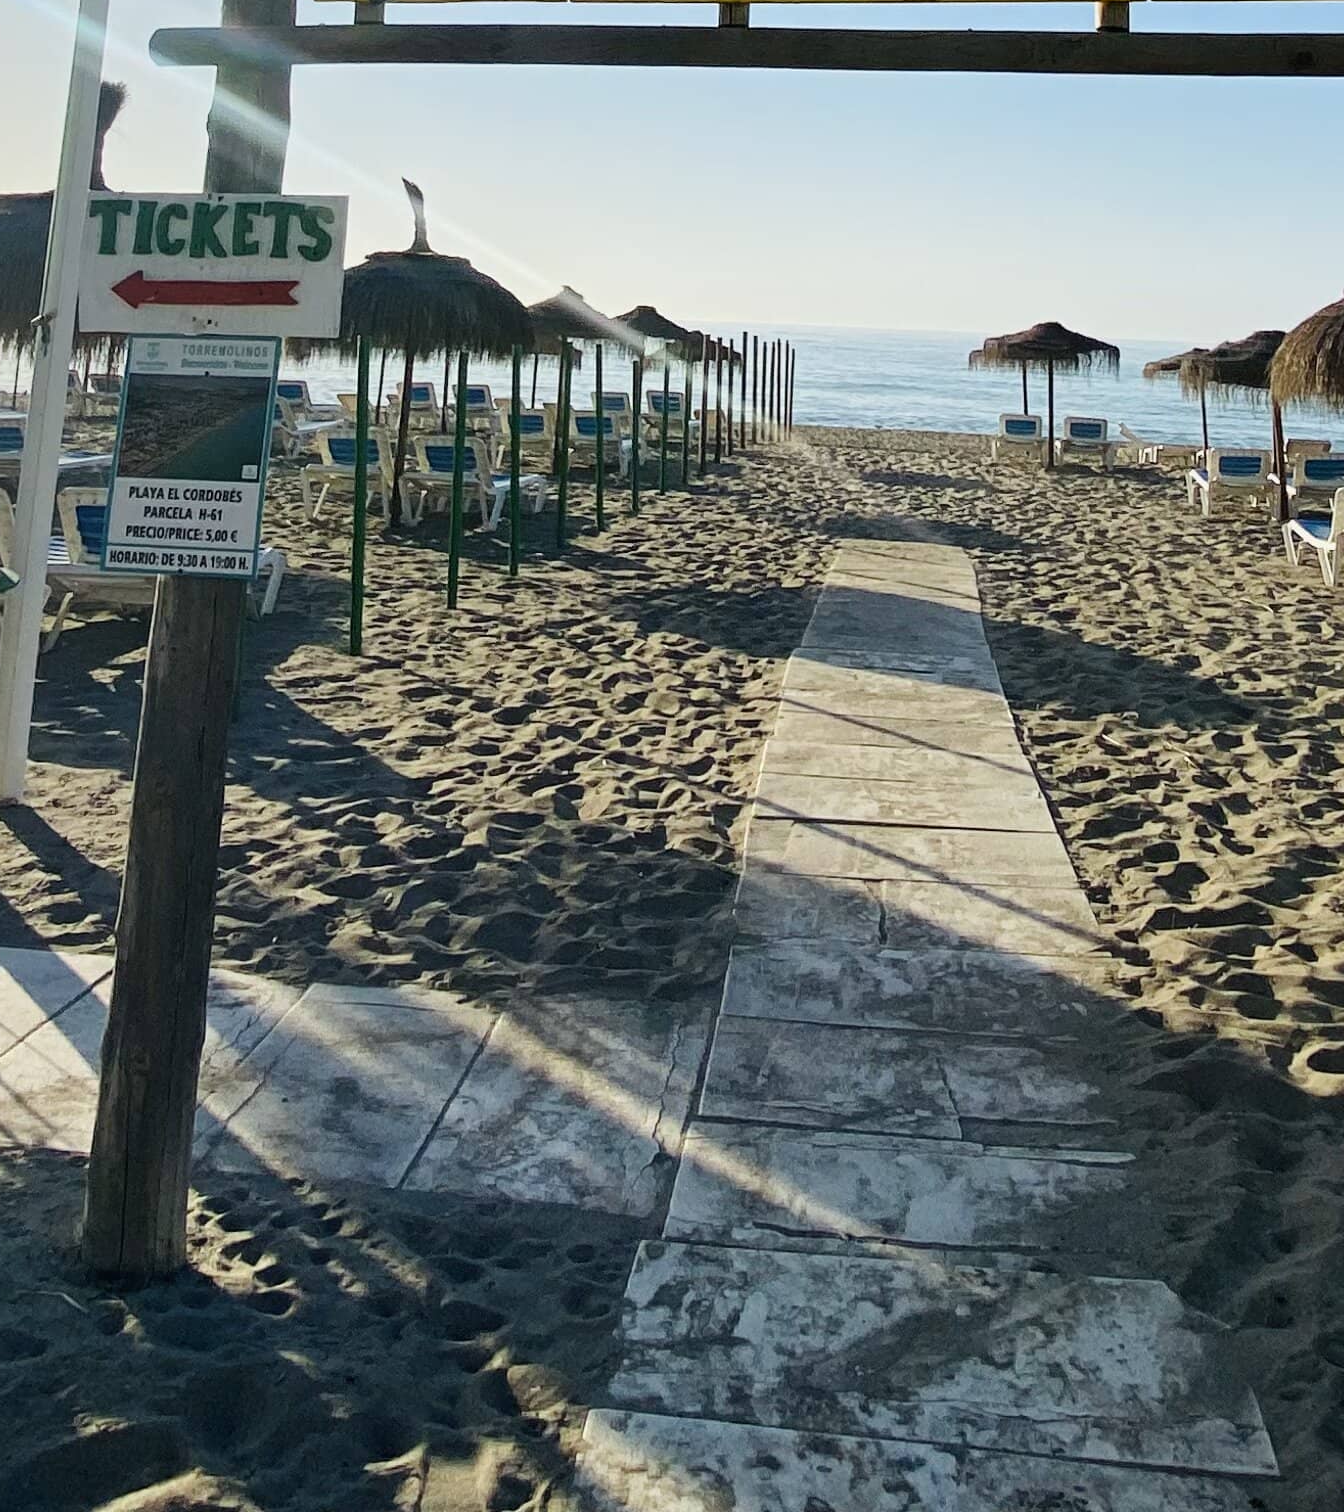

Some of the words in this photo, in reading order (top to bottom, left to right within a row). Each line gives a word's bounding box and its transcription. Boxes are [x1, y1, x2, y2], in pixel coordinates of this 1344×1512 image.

[88, 199, 335, 262] TICKETS
[181, 344, 269, 358] TORREMOLINOS
[128, 486, 165, 500] PLAYA
[167, 487, 180, 500] EL
[143, 506, 193, 520] PARCELA
[198, 508, 223, 521] H-61
[125, 525, 204, 541] PRECIO/PRICE:
[205, 529, 229, 543] 5,00
[230, 530, 238, 543] €
[109, 550, 159, 566] HORARIO:
[161, 553, 175, 566] DE
[177, 554, 198, 567] 9:30
[199, 555, 208, 568] A
